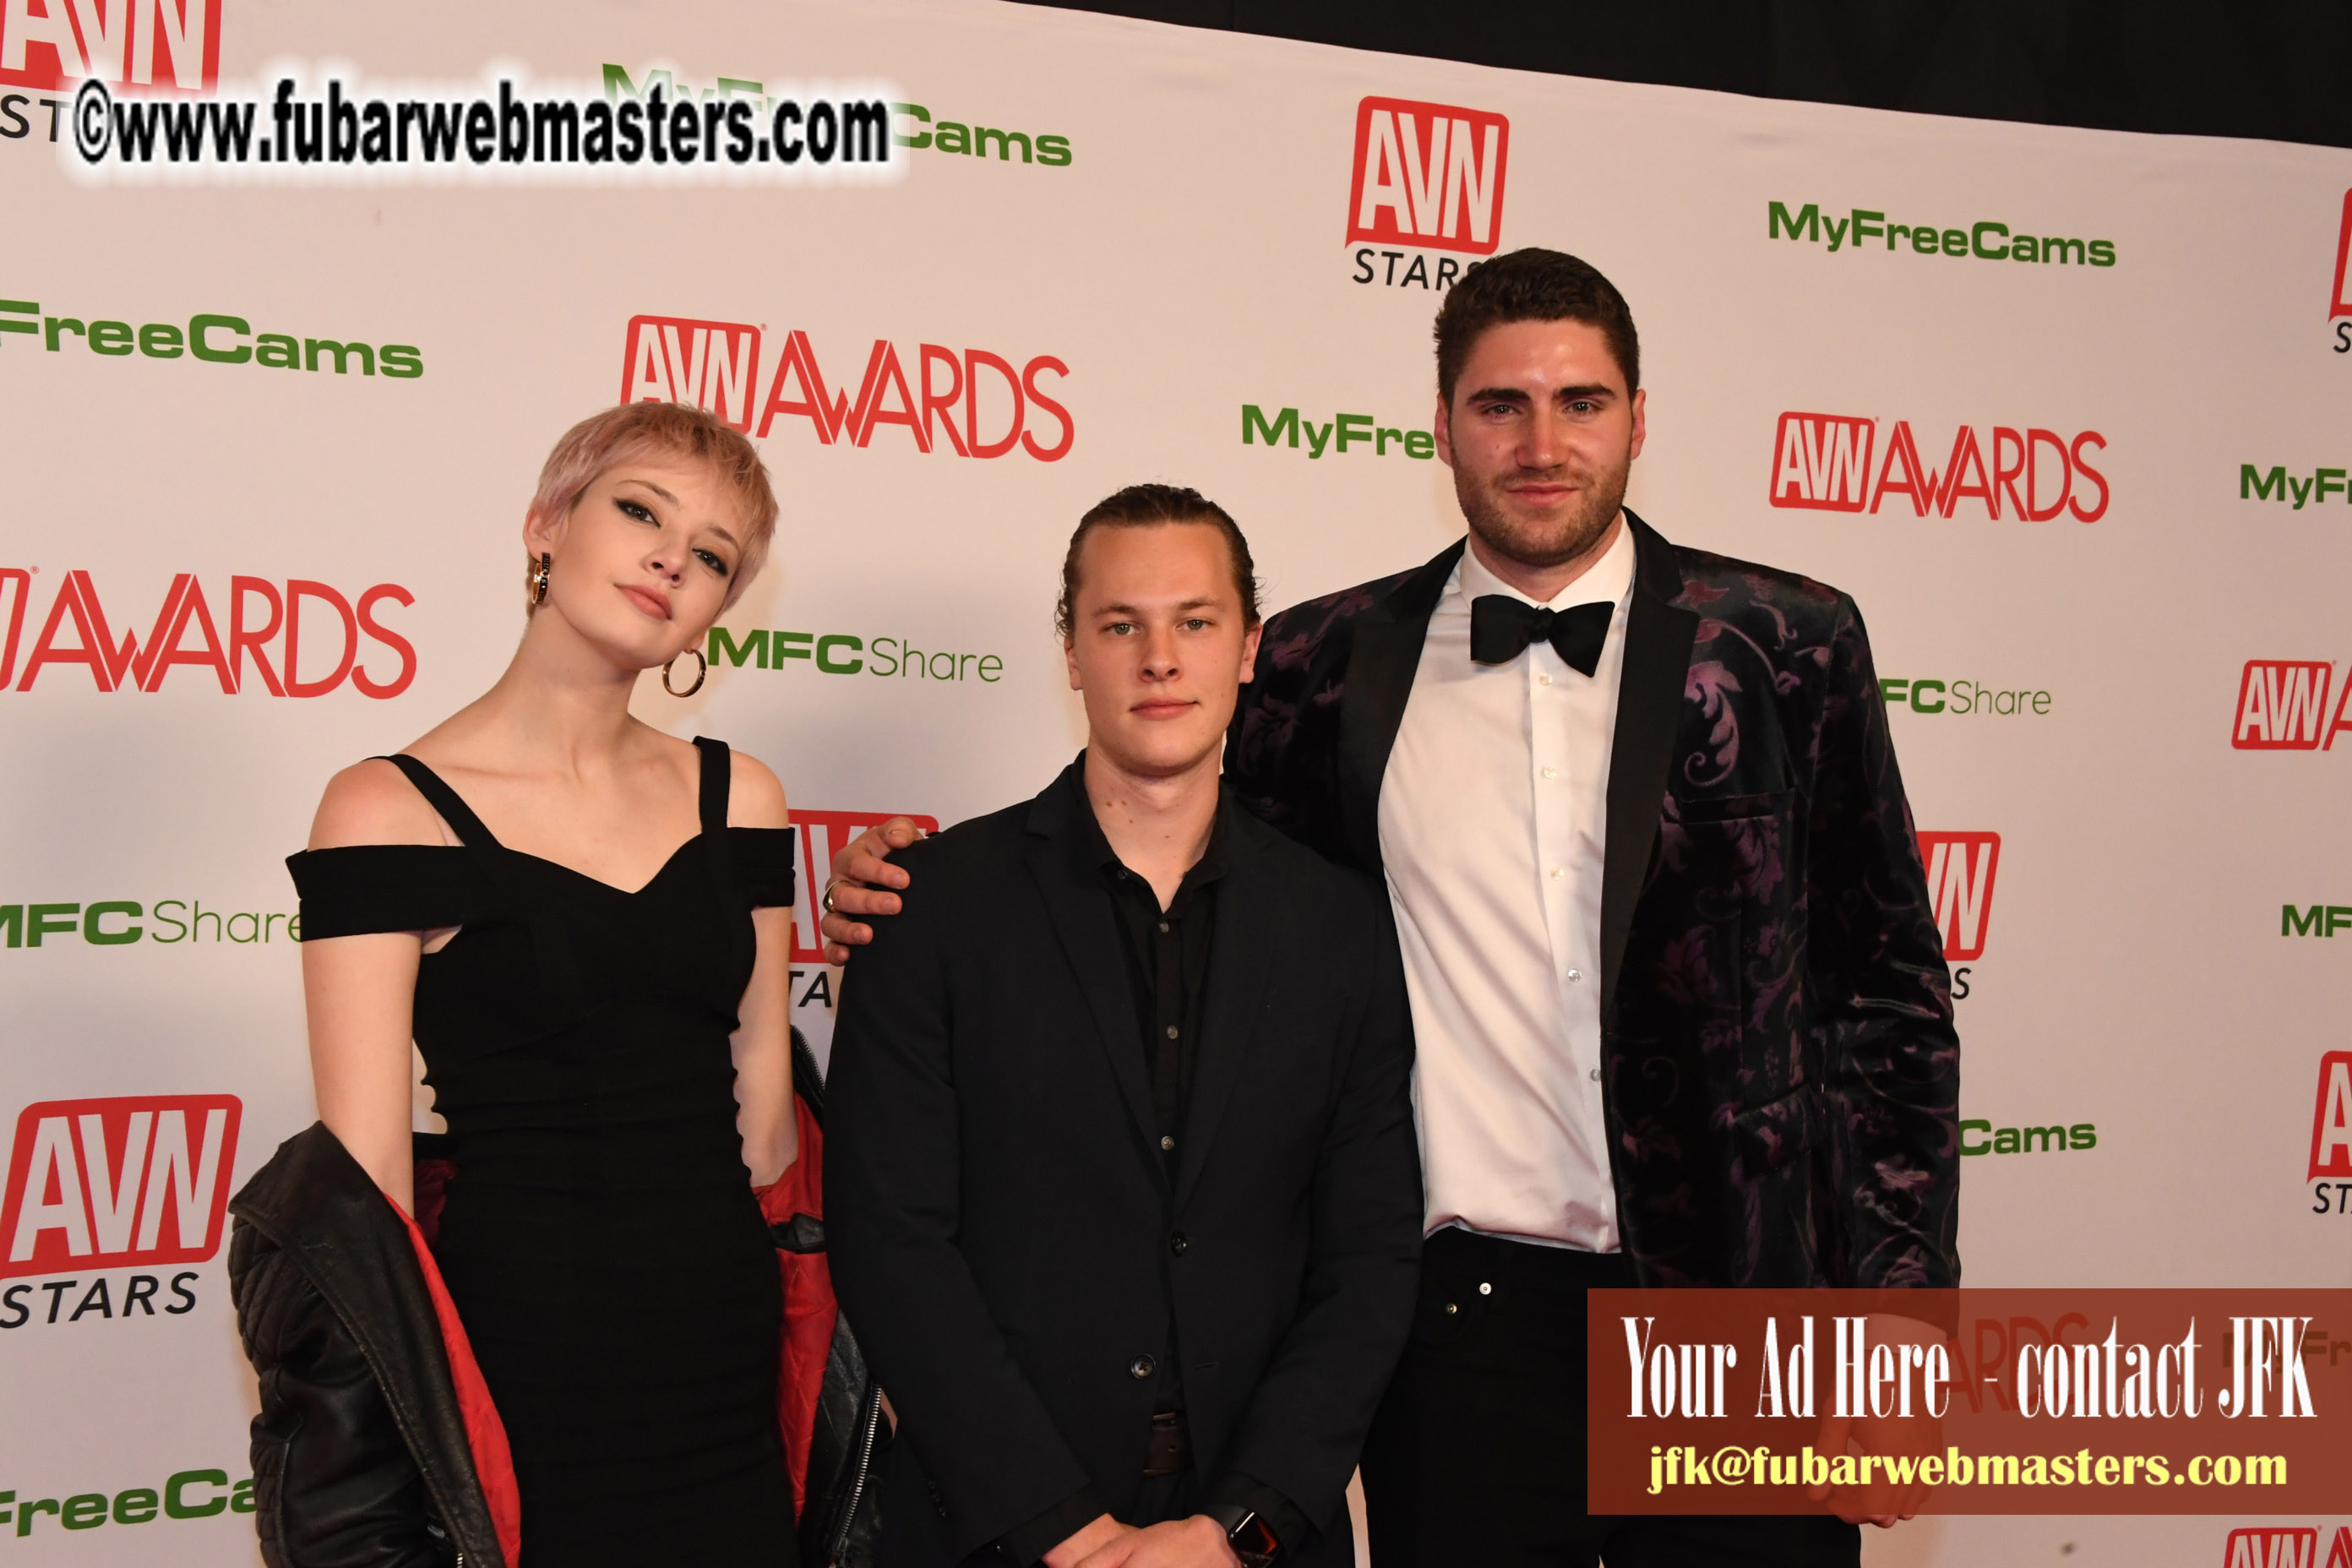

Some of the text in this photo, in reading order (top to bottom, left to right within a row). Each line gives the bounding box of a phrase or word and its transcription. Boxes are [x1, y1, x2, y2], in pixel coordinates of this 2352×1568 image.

[1358, 109, 1500, 243] AVN
[1768, 200, 2116, 267] MyFreeCams
[629, 324, 1075, 462] AVN AWARDS
[1774, 418, 2110, 523] AVN AWARDS
[2240, 464, 2352, 509] MyF
[15, 569, 417, 700] AWARDS
[2237, 666, 2327, 742] AVN
[8, 1108, 228, 1263] AVN
[0, 1271, 199, 1329] STARS
